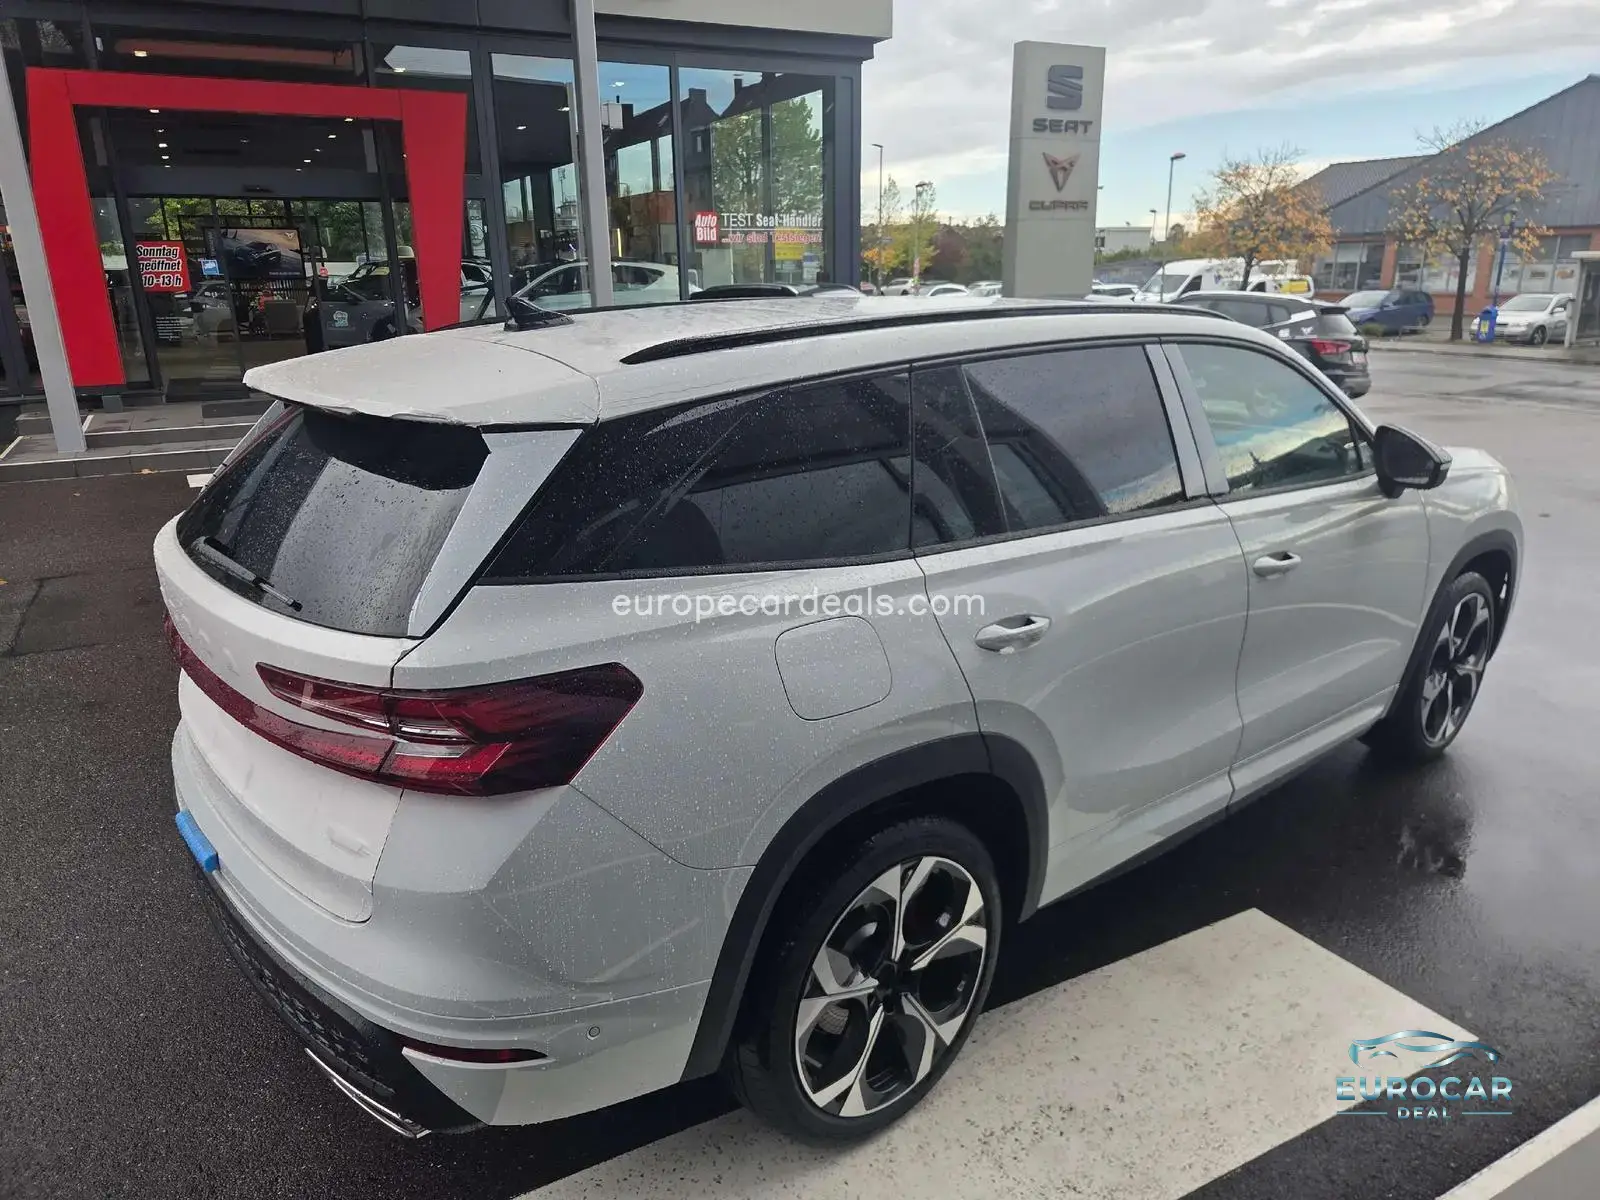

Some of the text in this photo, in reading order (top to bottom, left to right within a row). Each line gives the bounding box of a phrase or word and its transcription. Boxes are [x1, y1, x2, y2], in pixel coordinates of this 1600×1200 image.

[1032, 118, 1093, 134] SEAT
[1028, 200, 1089, 212] CUPRA
[695, 214, 718, 228] Auto
[720, 212, 823, 227] TEST Seat-Händler
[696, 227, 717, 241] Bild
[136, 245, 179, 259] Sonntag
[142, 273, 183, 287] 10-13 h
